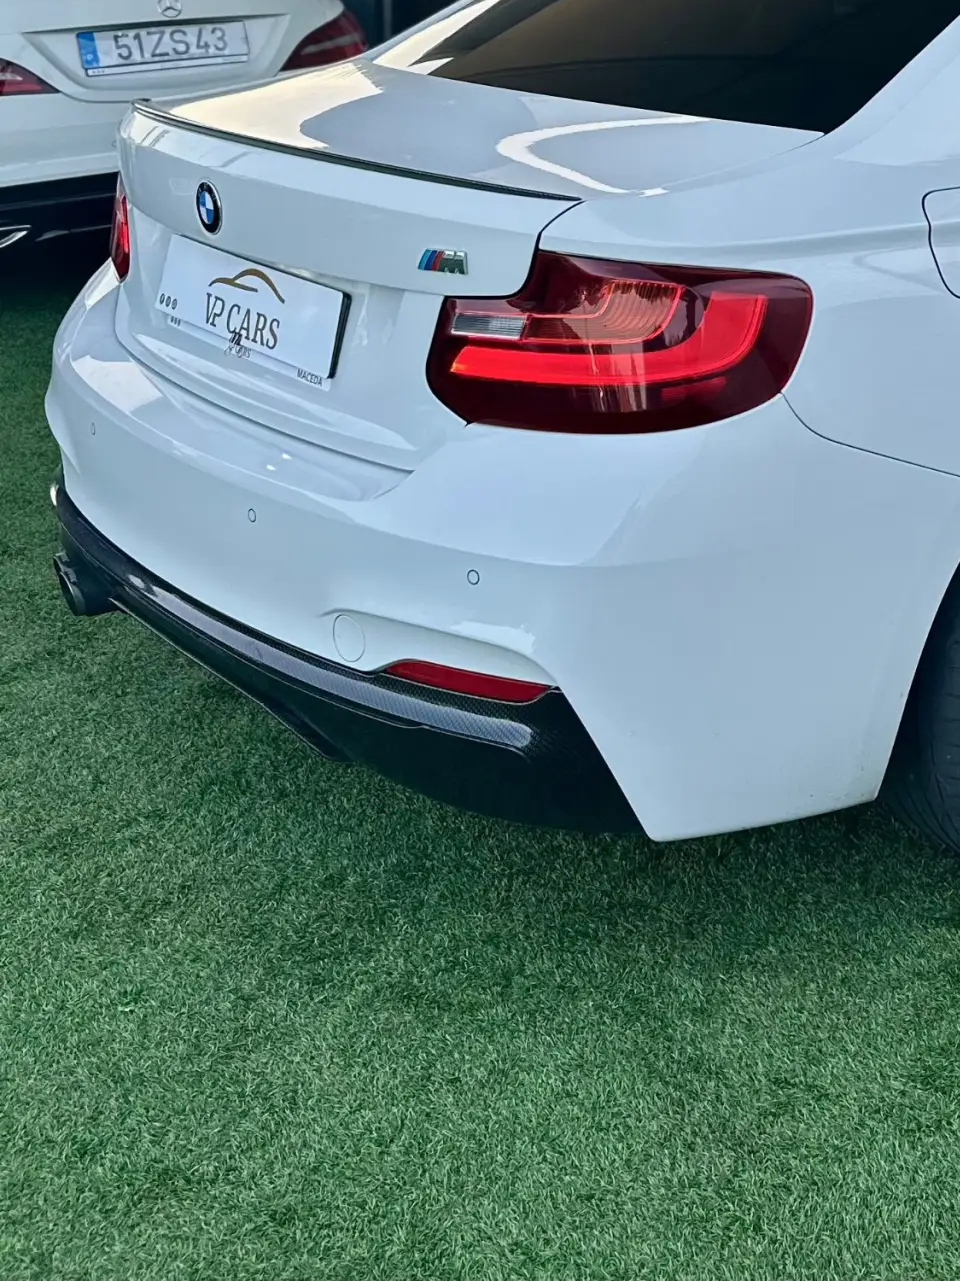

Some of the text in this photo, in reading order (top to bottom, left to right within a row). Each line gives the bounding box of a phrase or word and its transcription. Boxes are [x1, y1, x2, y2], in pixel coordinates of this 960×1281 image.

[113, 26, 228, 61] 51ZS43
[206, 292, 280, 350] VP CARS
[297, 368, 322, 386] MACEDA
